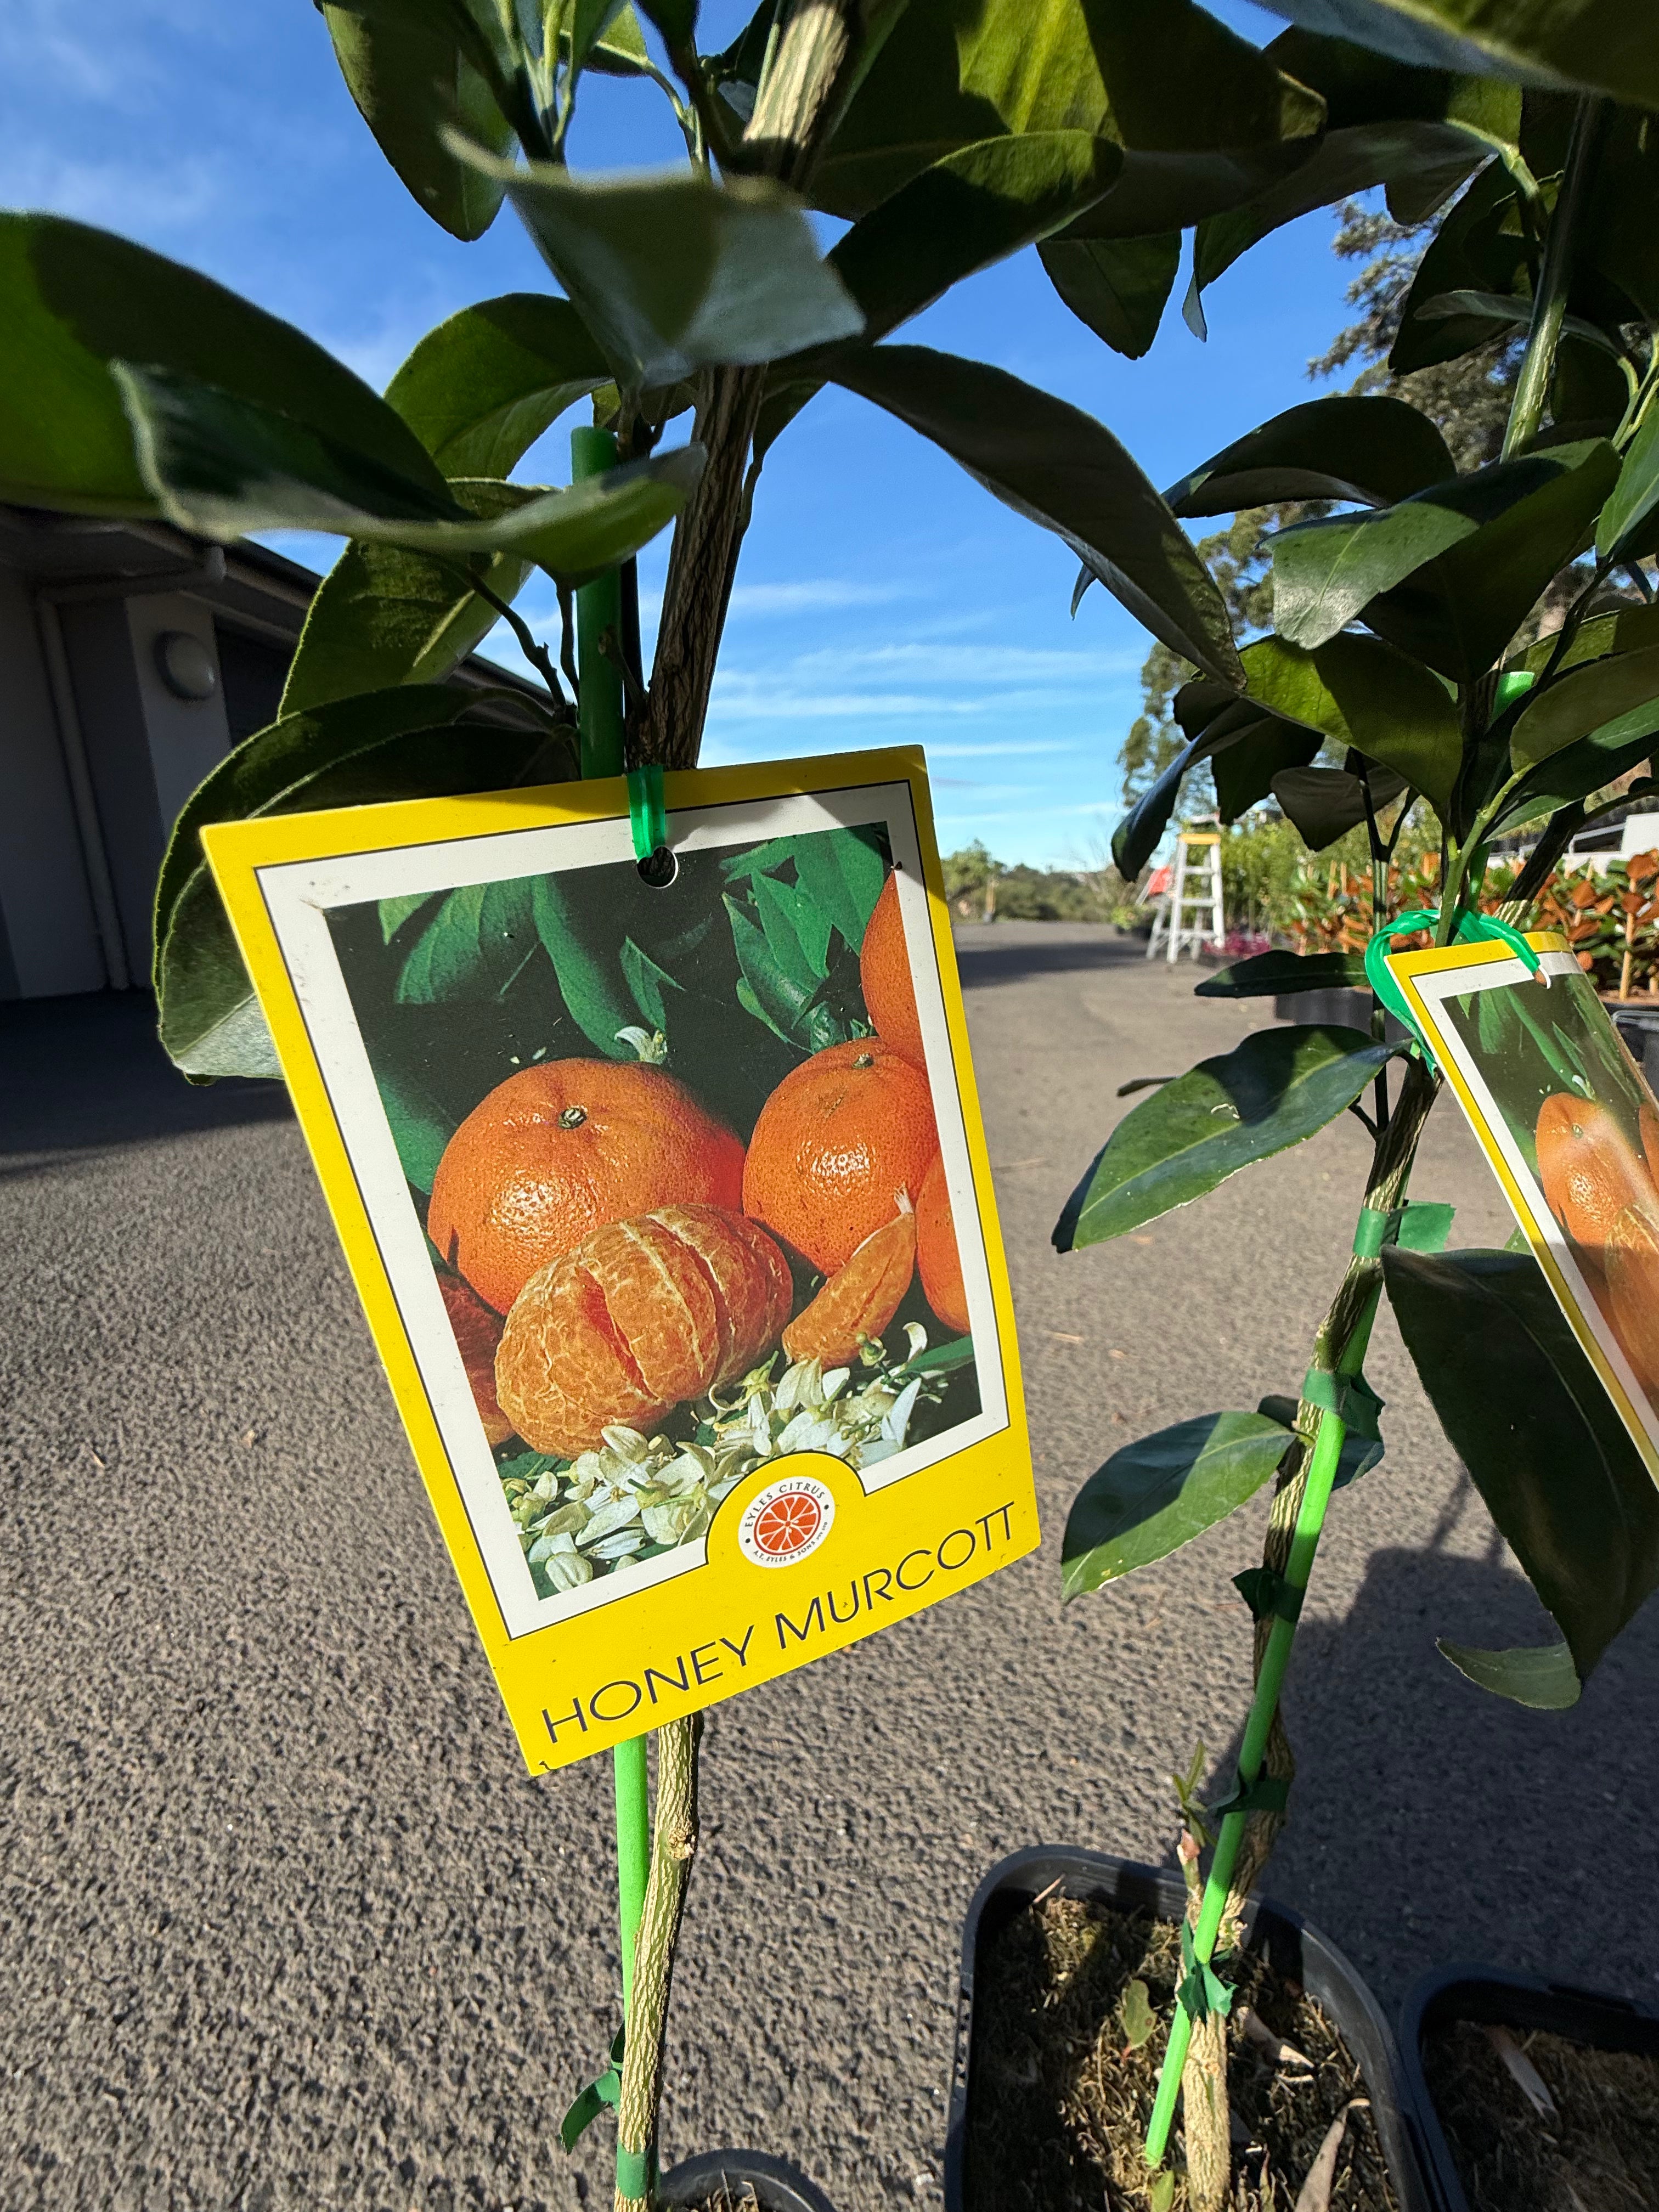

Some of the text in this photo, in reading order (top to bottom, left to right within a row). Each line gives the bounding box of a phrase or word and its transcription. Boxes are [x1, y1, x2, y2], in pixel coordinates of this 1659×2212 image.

[744, 1482, 825, 1528] EYLES CITRUS
[797, 1541, 816, 1556] SONS
[542, 1501, 1014, 1743] HONEY MURCOTT
